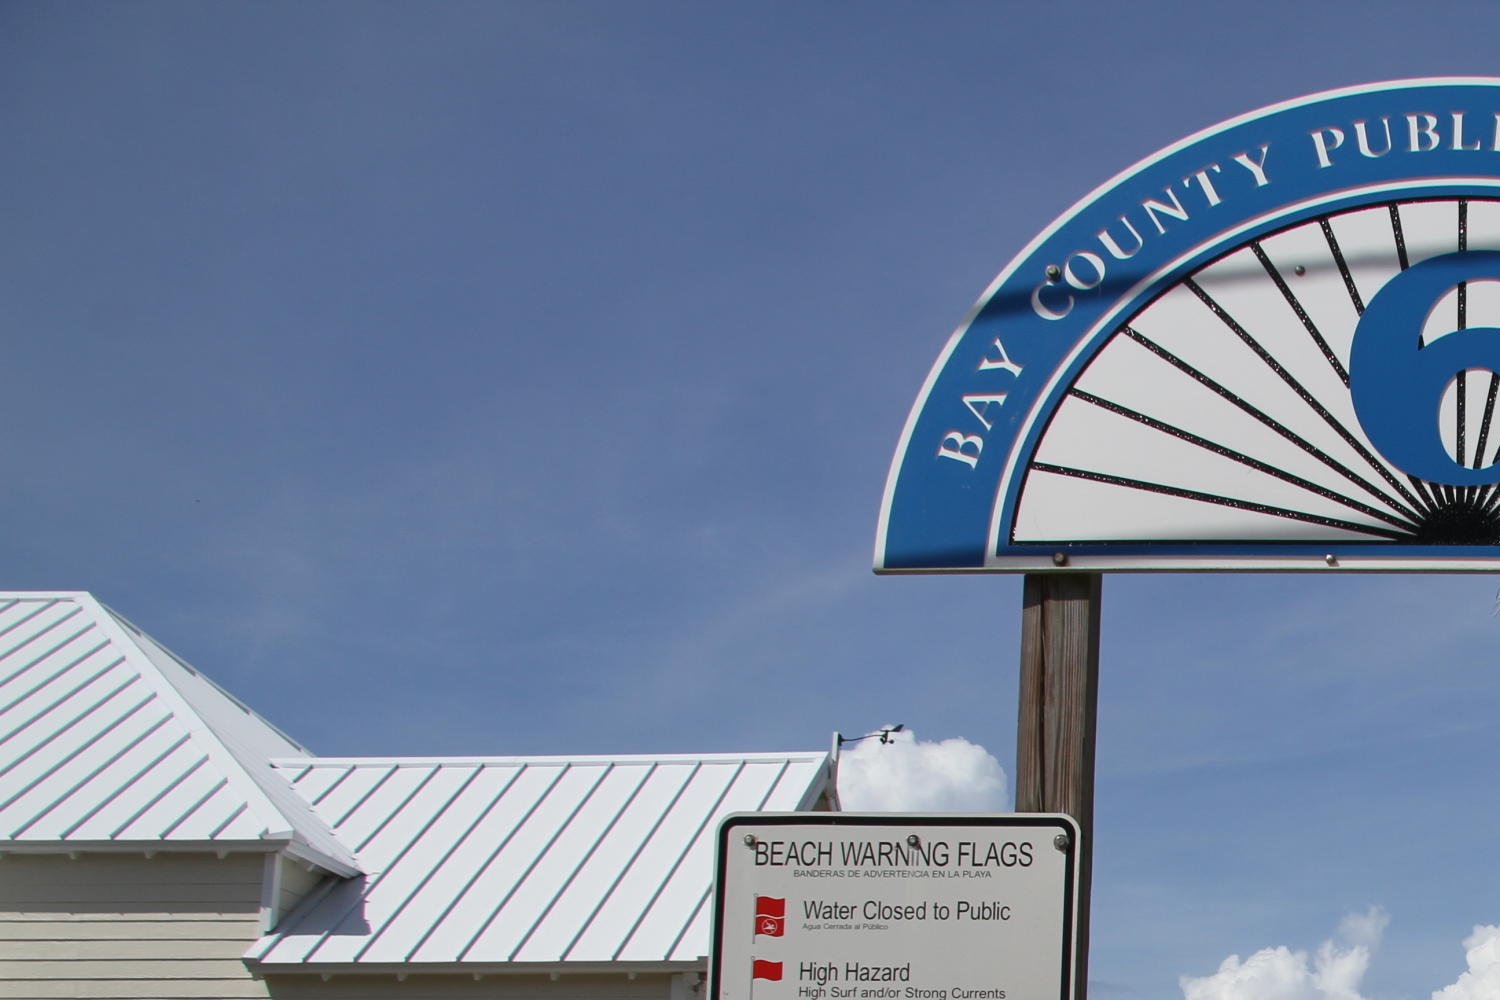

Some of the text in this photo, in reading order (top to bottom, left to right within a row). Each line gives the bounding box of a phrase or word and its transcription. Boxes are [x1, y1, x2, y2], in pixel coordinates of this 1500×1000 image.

[936, 337, 1026, 470] BAY
[1031, 143, 1271, 320] COUNTY
[754, 840, 1033, 867] BEACH WARNING FLAGS
[793, 869, 845, 877] BANDERAS
[863, 870, 929, 878] ADVERTENCIA
[931, 870, 945, 878] EN
[947, 870, 960, 878] LA
[962, 870, 992, 878] PLAYA
[803, 900, 1010, 920] Water Closed to Public
[799, 962, 910, 986] High Hazard
[798, 985, 1006, 1000] High Surf and/or Strong Currents
